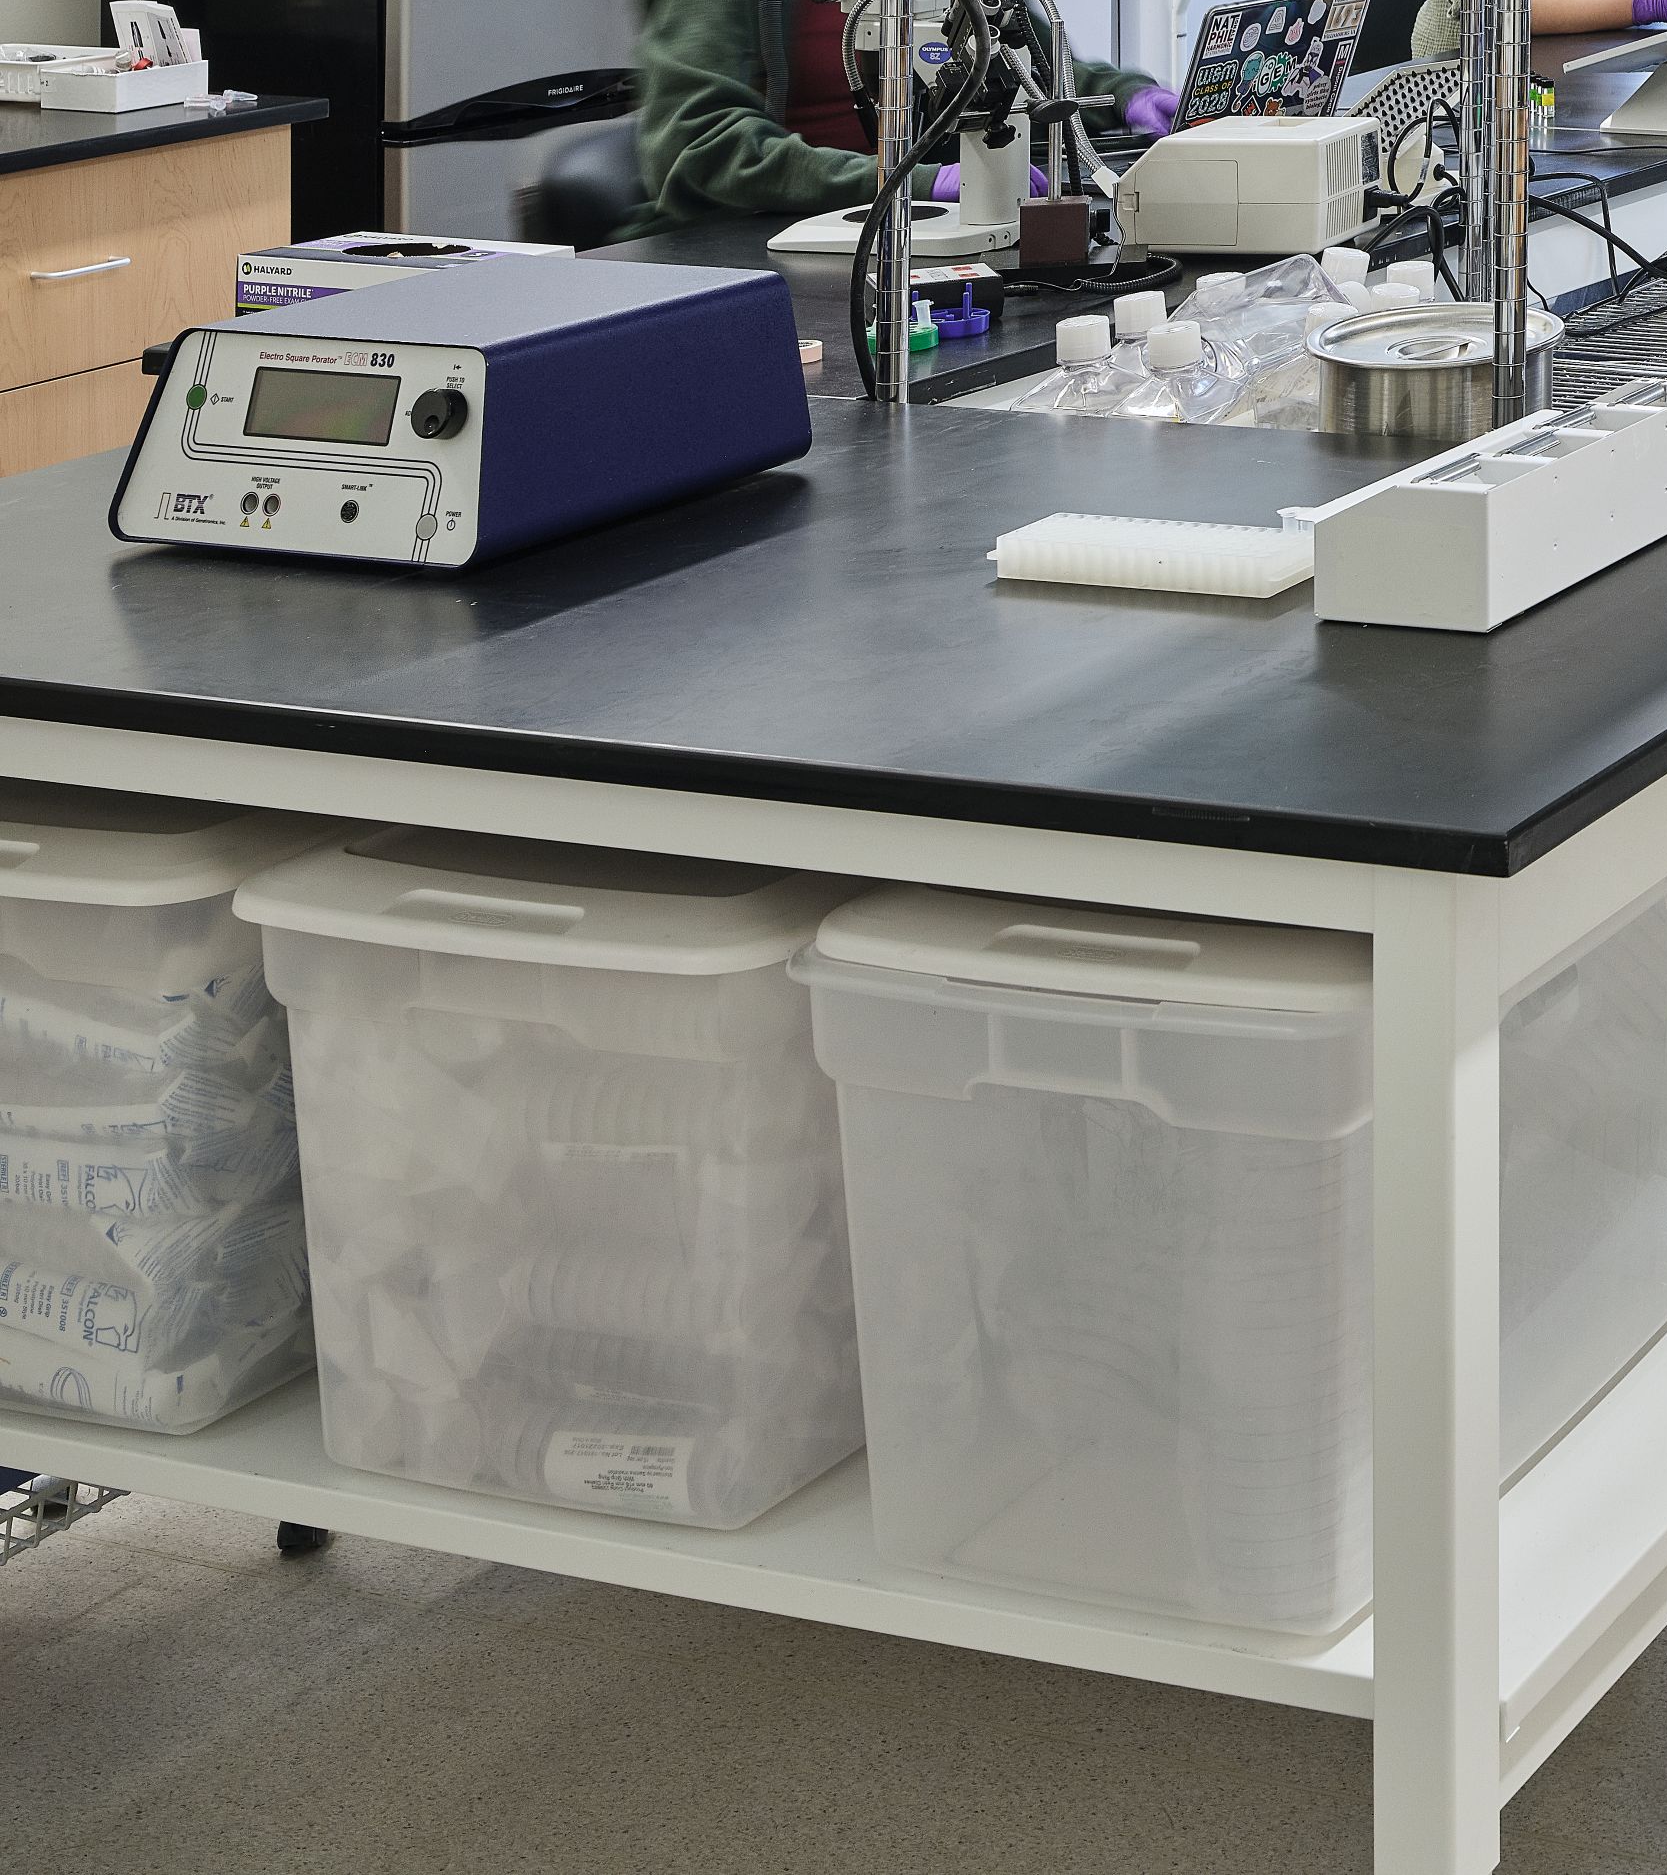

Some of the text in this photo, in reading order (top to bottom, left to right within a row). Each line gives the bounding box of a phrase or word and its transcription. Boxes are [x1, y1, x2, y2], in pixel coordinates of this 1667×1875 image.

[1212, 15, 1240, 32] NAT
[1209, 28, 1234, 45] PHIL
[548, 85, 584, 96] FRIGIDAIRE
[1195, 80, 1233, 96] CLASS OF
[1189, 90, 1229, 115] 2028
[253, 265, 293, 276] HALYARD
[243, 284, 277, 296] PURPLE
[242, 294, 283, 305] POWDER-FREE
[259, 351, 284, 363] Electro
[285, 353, 310, 364] Square
[344, 351, 368, 367] ECM
[370, 352, 395, 368] 830
[446, 382, 463, 390] SELECT
[446, 510, 462, 518] POWER
[85, 1164, 96, 1215] FALCO
[58, 1298, 68, 1332] 351008
